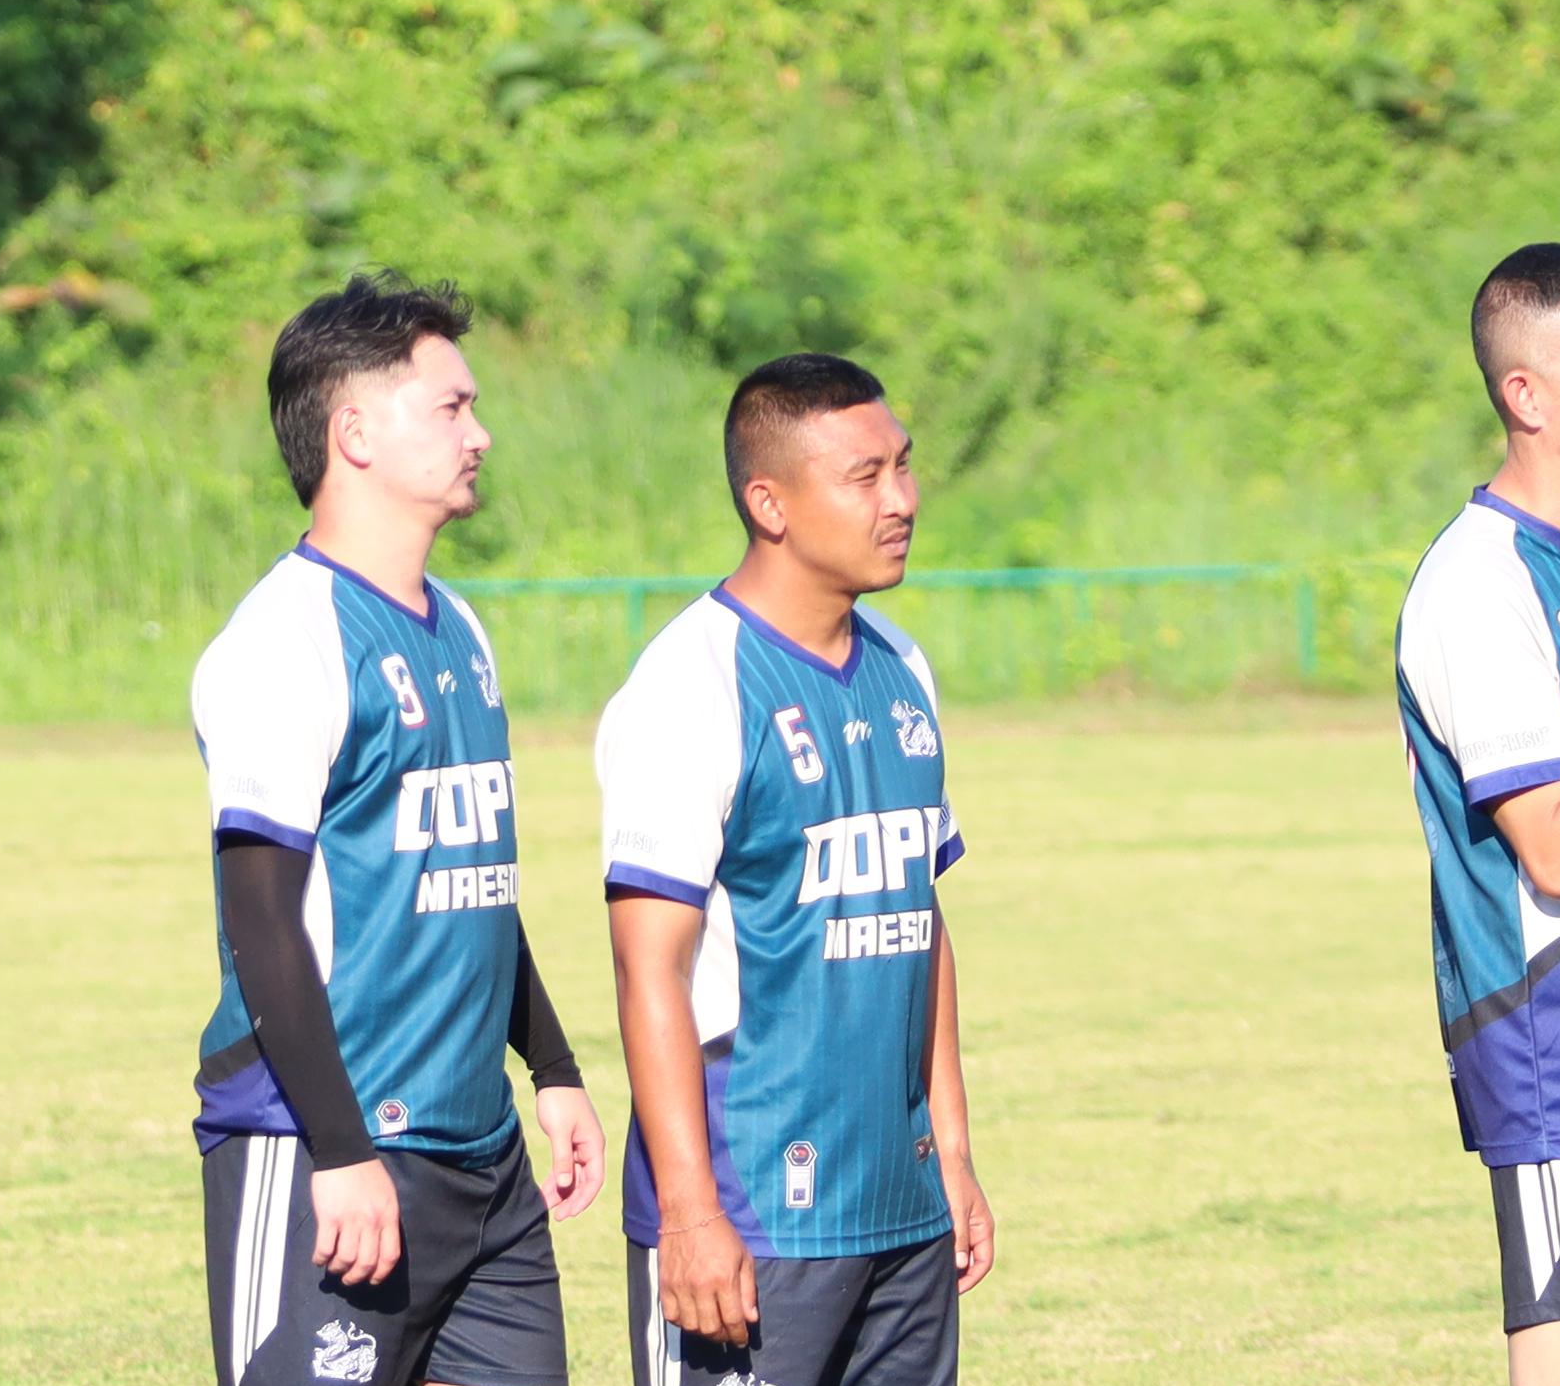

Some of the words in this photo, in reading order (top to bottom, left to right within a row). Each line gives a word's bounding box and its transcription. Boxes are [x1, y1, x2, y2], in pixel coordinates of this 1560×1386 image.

[381, 653, 429, 730] 8
[774, 704, 825, 785] 5
[393, 760, 517, 852] DOP
[415, 863, 519, 915] MAESO
[823, 910, 933, 961] MAESO
